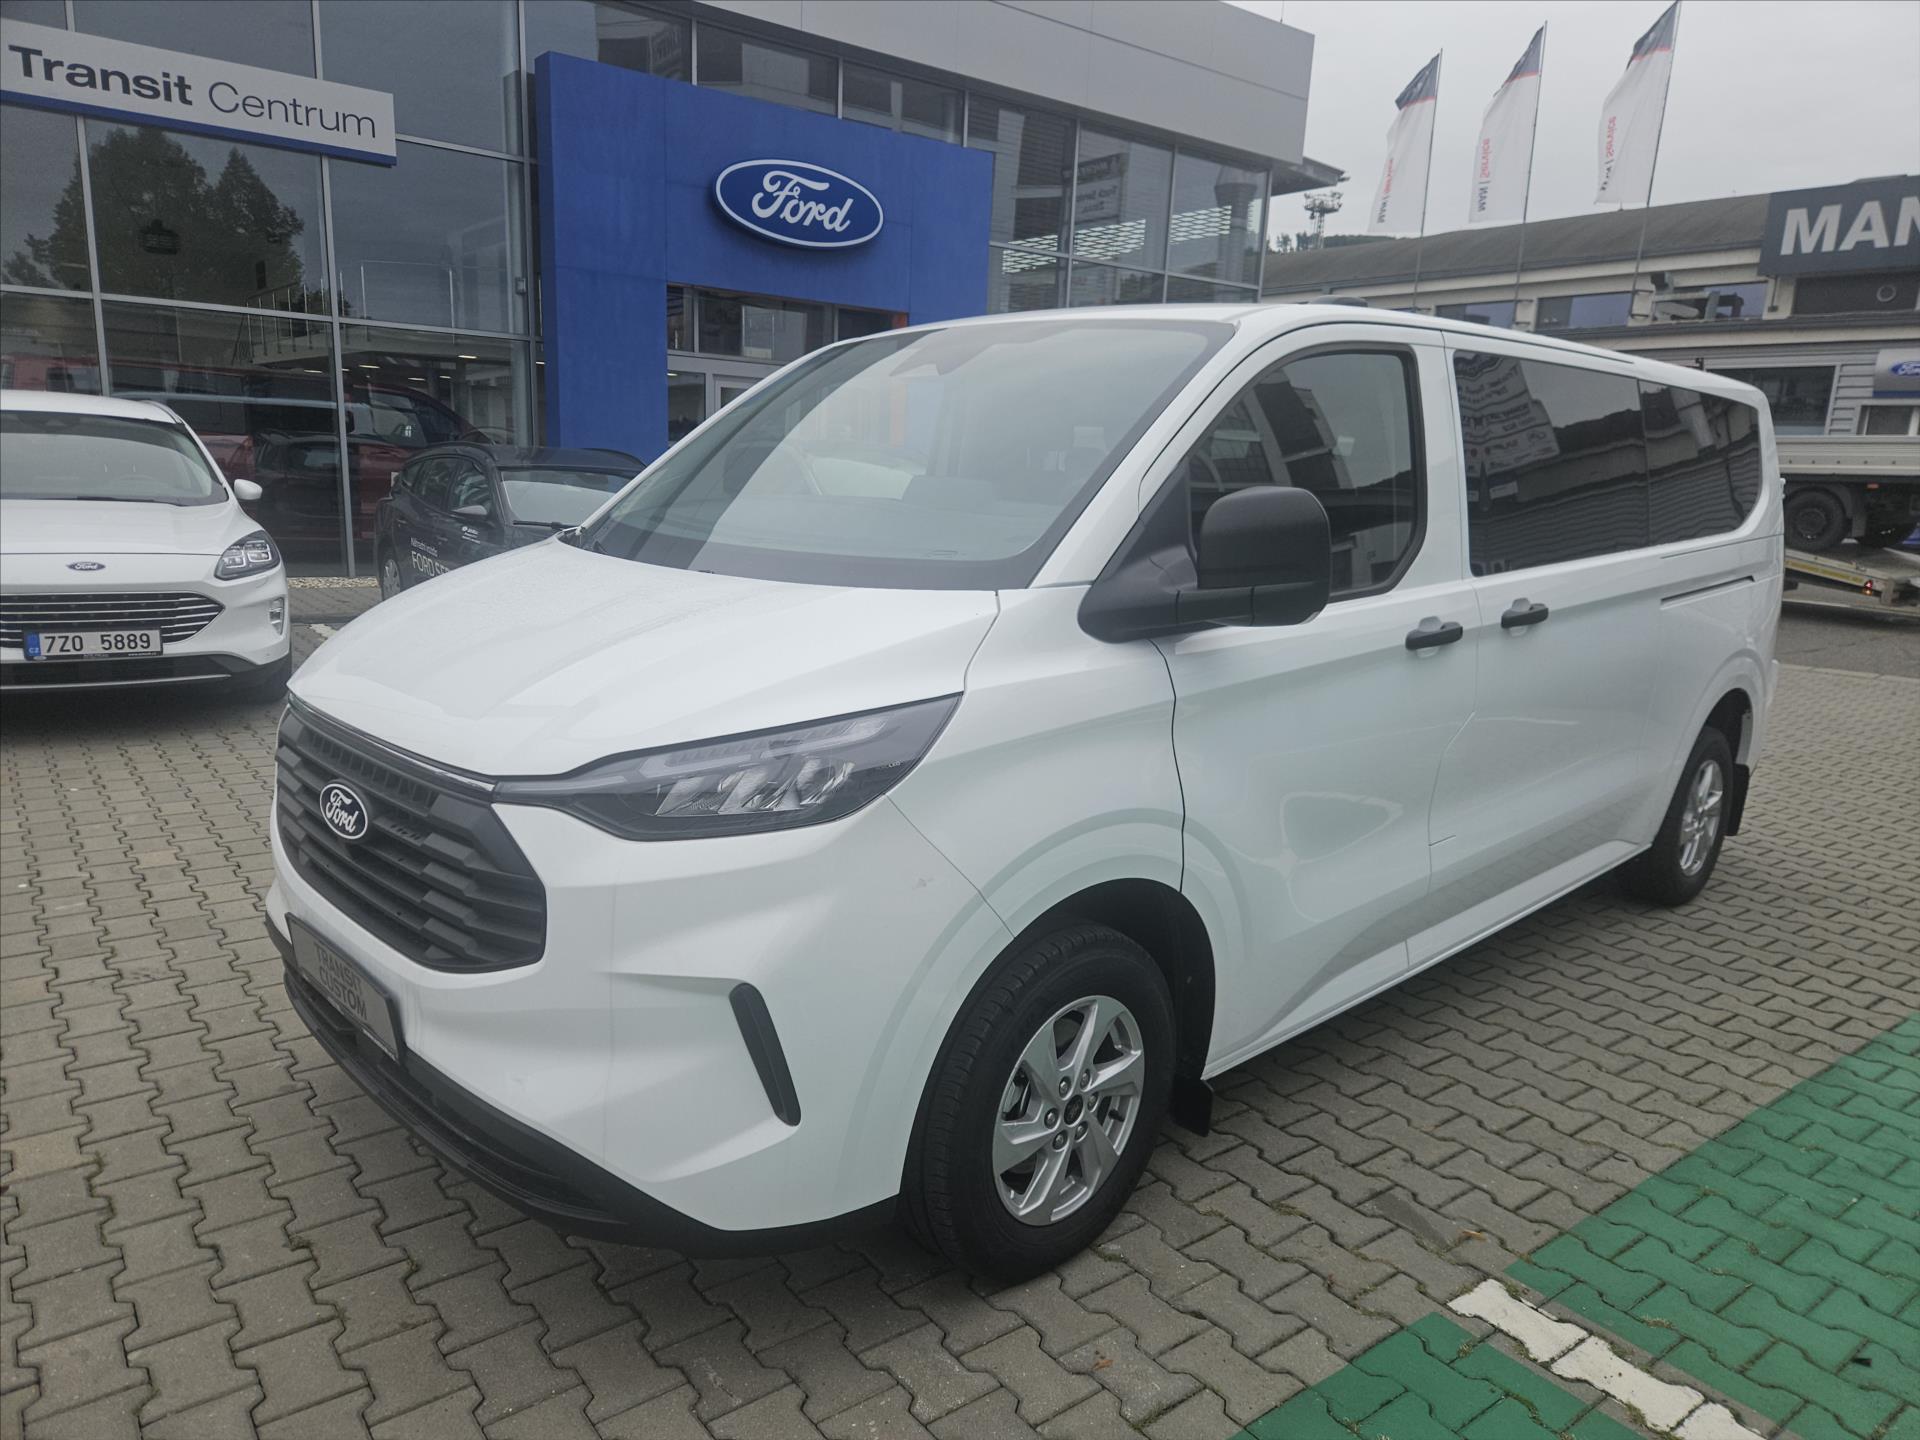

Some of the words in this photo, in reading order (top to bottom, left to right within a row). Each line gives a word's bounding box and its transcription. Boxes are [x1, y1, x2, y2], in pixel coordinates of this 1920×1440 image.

[8, 44, 193, 106] Transit
[207, 81, 376, 139] Centrum
[751, 170, 854, 232] Ford
[411, 551, 435, 577] FORD
[100, 633, 151, 652] 5889
[325, 789, 359, 833] Ford
[314, 942, 363, 995] TRANSIT
[319, 966, 368, 1021] CUSTOM
